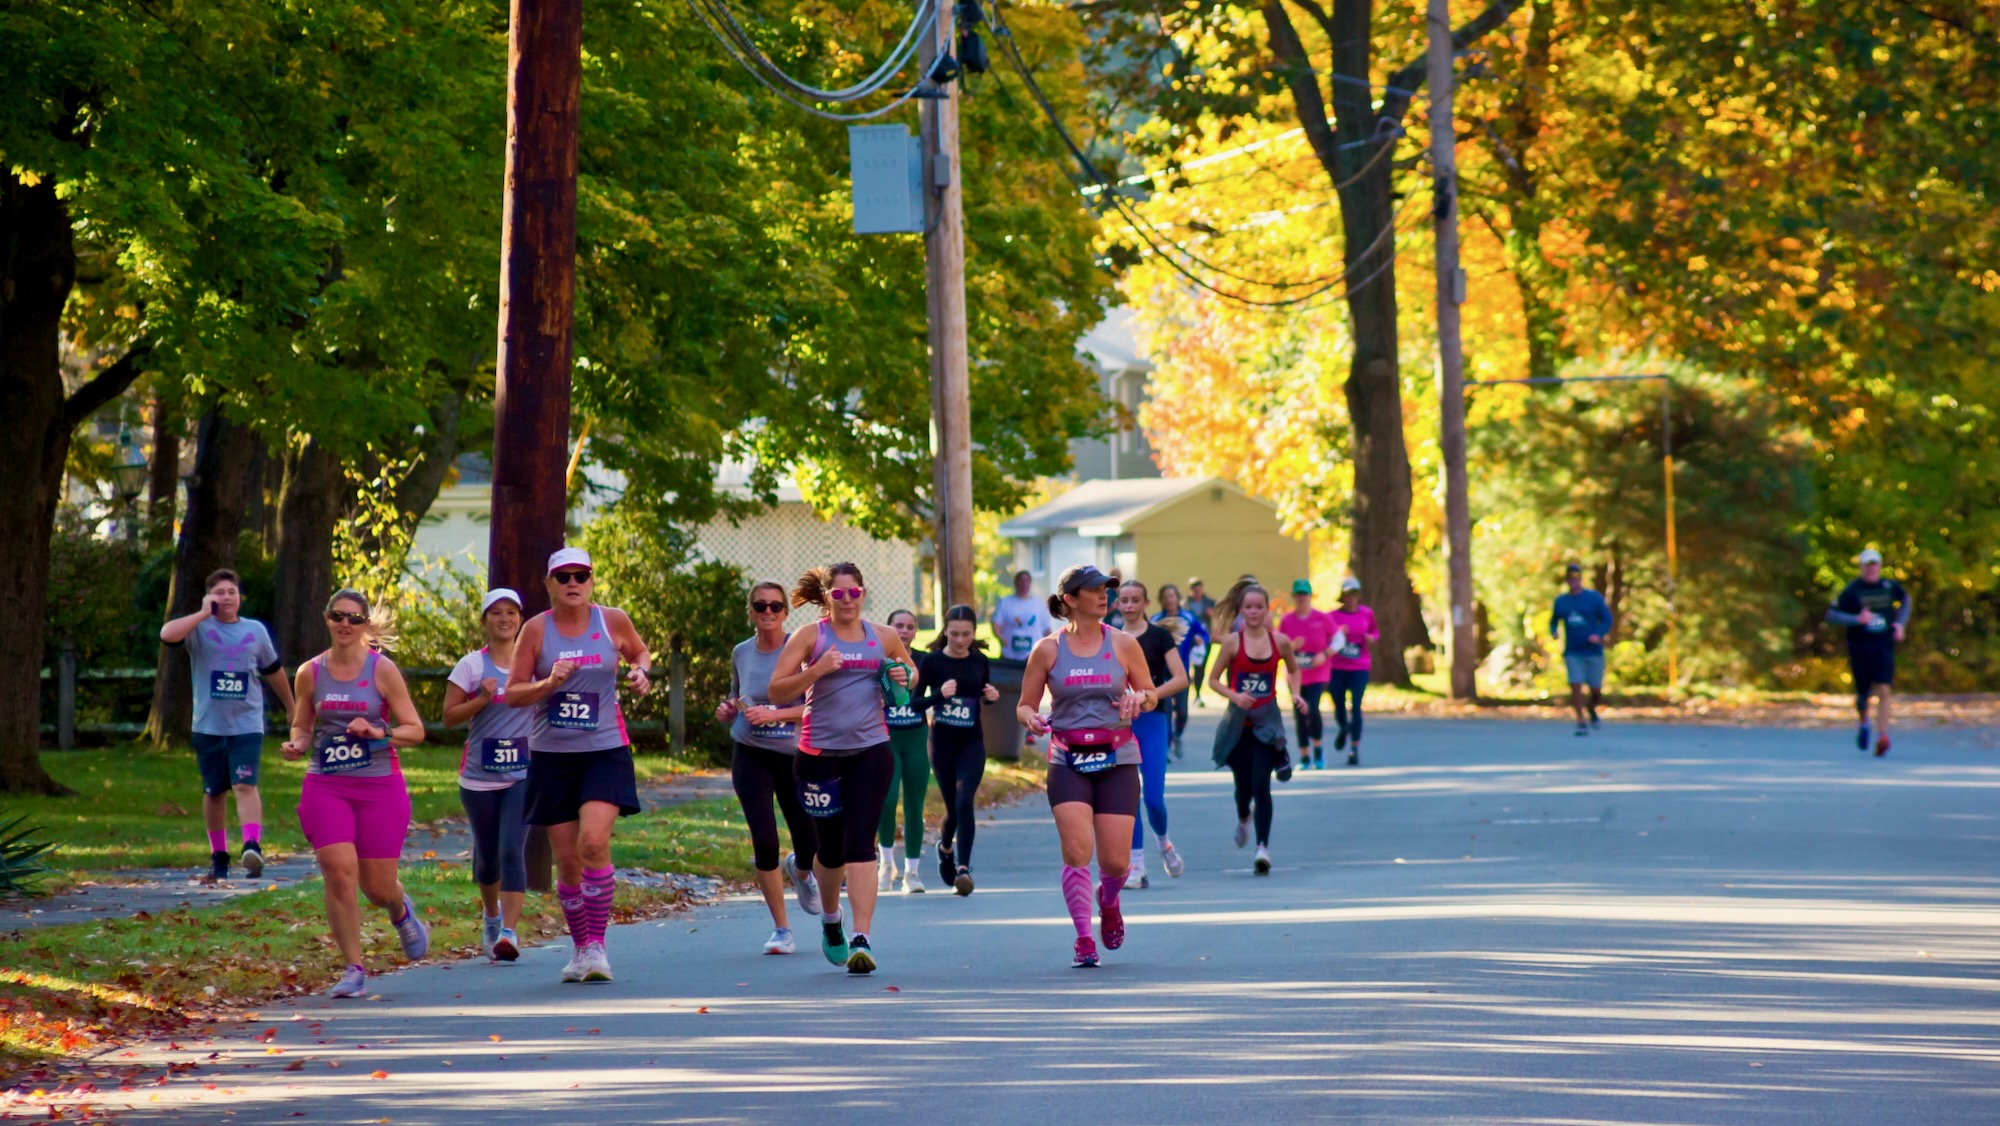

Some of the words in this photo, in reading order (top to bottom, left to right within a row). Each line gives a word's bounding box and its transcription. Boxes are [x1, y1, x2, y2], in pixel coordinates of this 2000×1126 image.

[559, 650, 583, 659] SOLE
[1070, 668, 1094, 677] SOLE
[216, 679, 243, 692] 328
[1241, 680, 1267, 691] 376
[559, 703, 590, 719] 312
[942, 704, 970, 719] 348
[324, 743, 363, 763] 206
[494, 748, 518, 763] 311
[804, 792, 831, 807] 319
